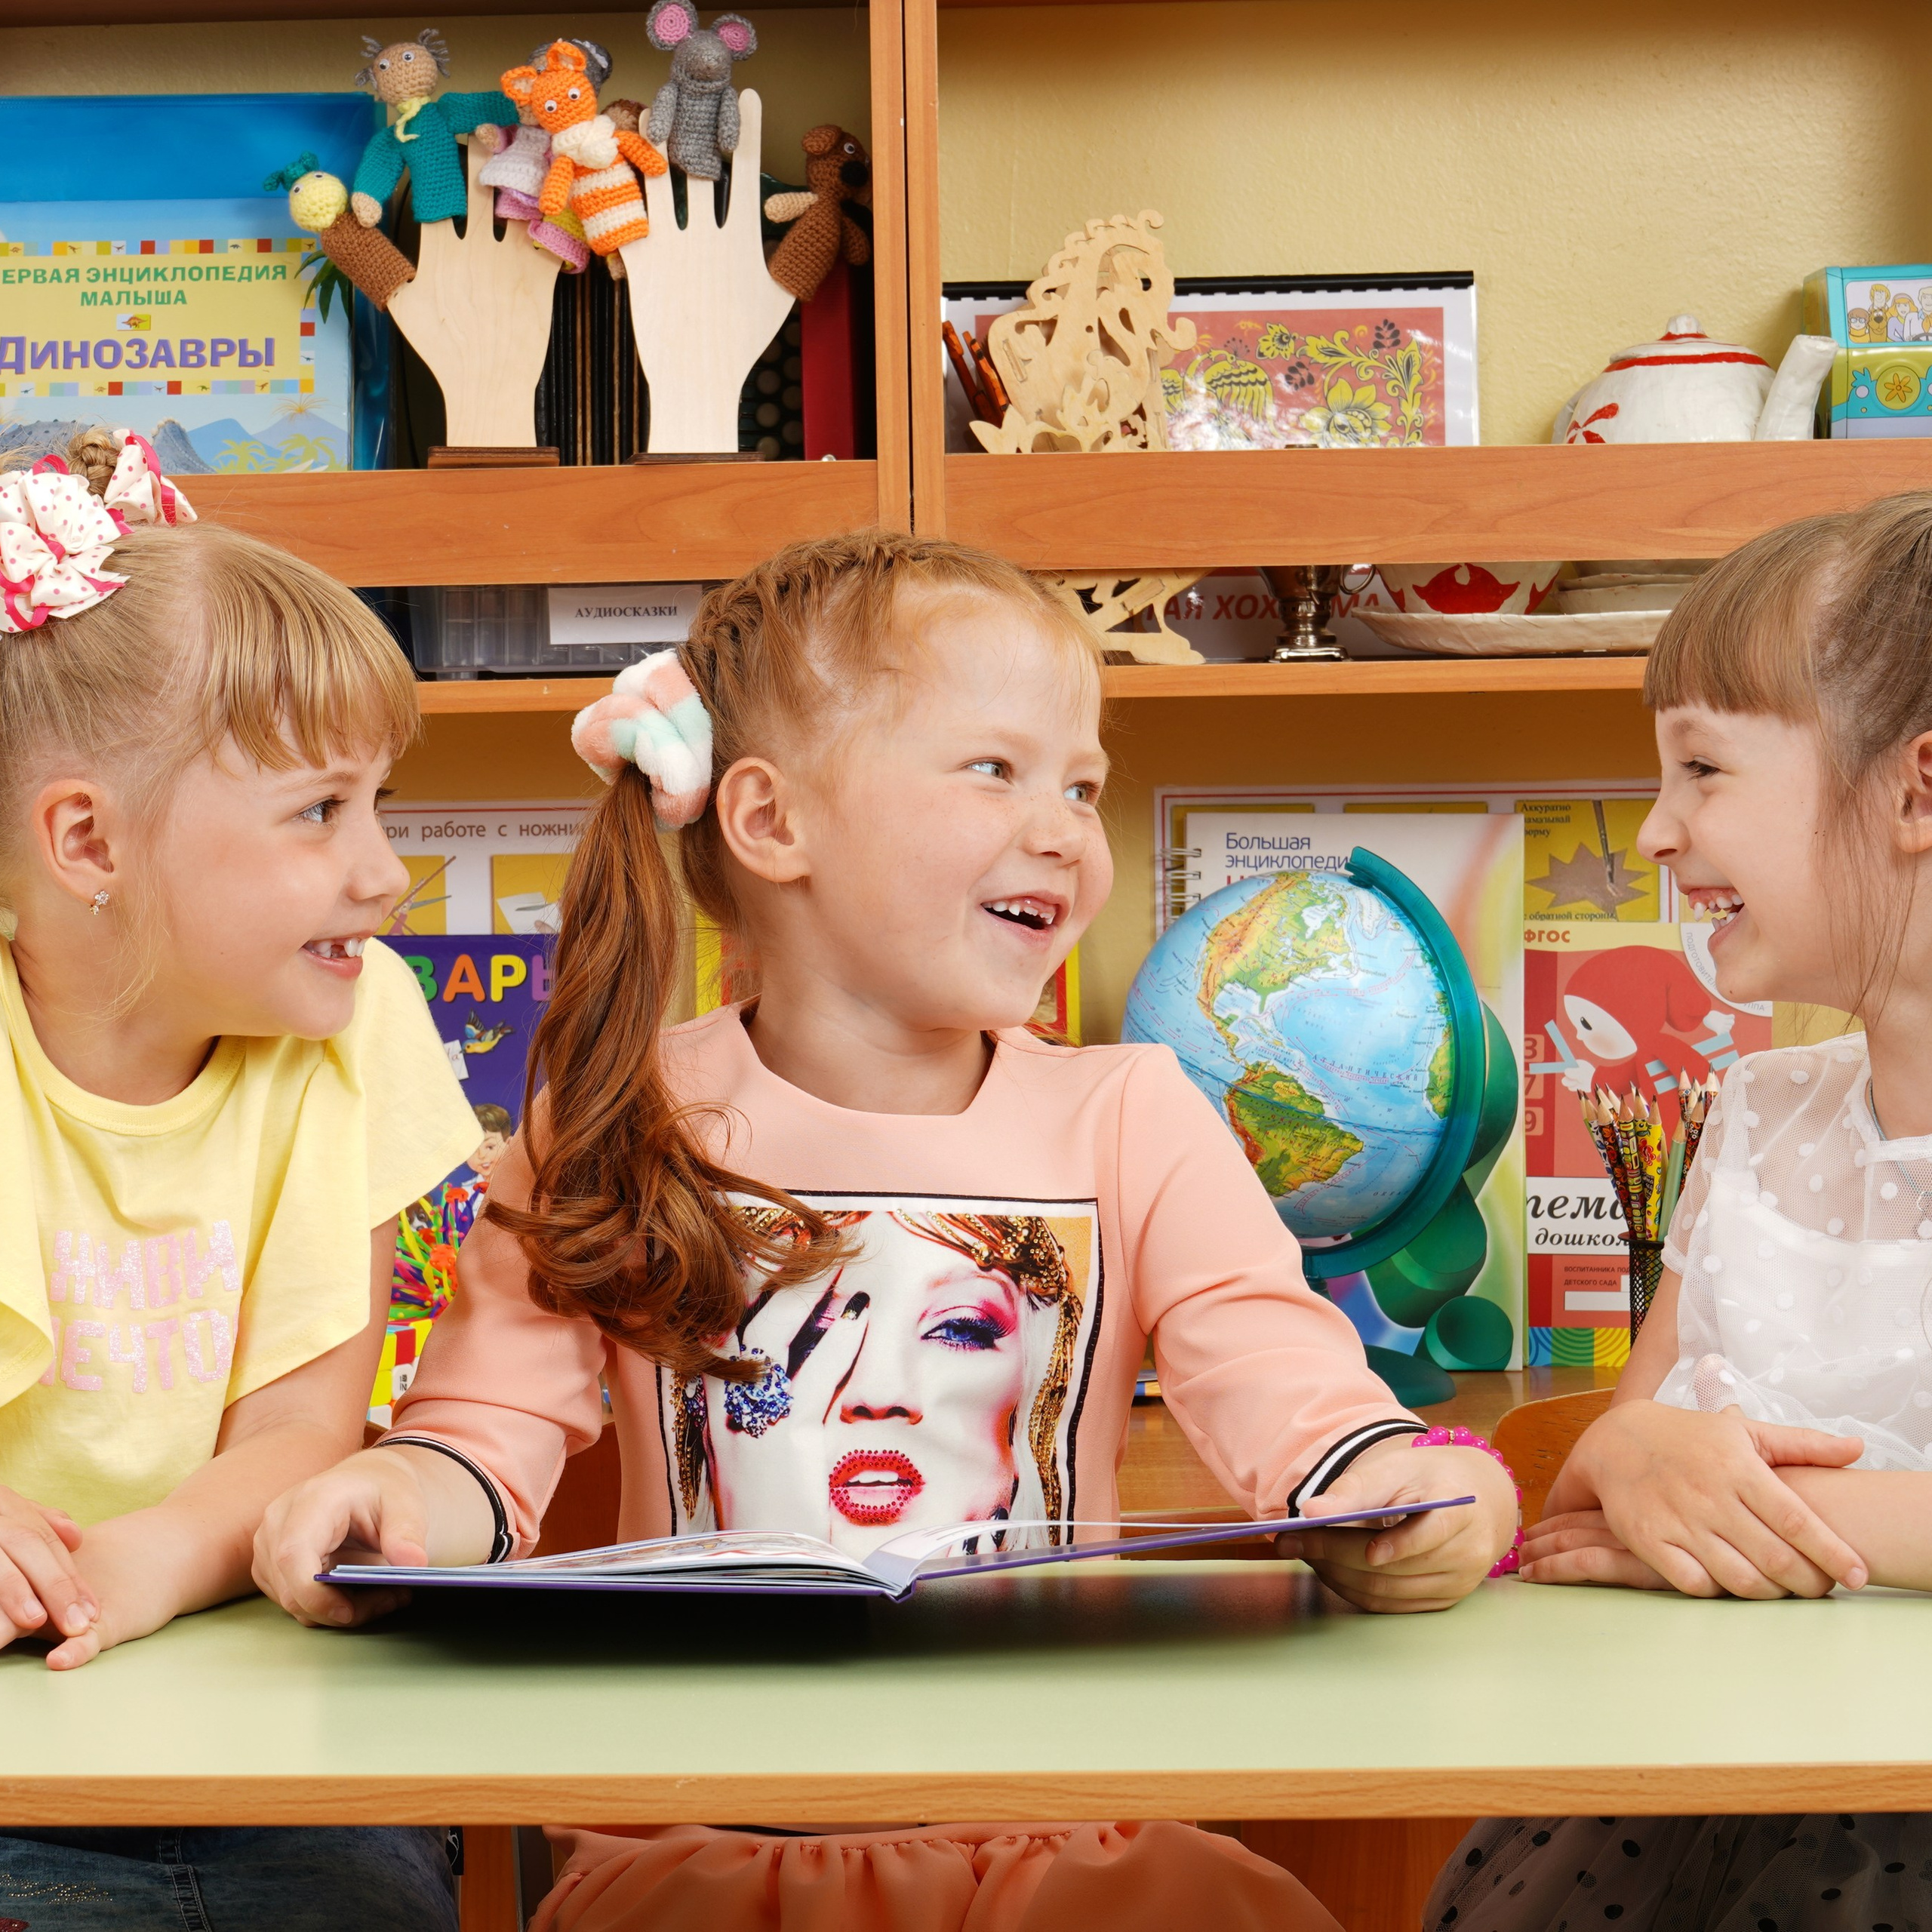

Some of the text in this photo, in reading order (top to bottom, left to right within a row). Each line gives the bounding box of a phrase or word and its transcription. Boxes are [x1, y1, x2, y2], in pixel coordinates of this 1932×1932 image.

[2, 265, 287, 285] ЕРВАЯ ЭНЦИКЛОПЕДИЯ
[80, 290, 188, 306] МАЛЫША
[0, 337, 275, 375] ДИНОЗАВРЫ
[575, 606, 678, 619] АУДИОСКАЗКИ
[1212, 593, 1380, 620] ХОХМА
[382, 825, 409, 838] ри
[422, 821, 486, 841] работе
[497, 824, 507, 837] с
[1226, 832, 1311, 851] Большая
[1529, 911, 1573, 921] обратной
[1524, 929, 1571, 943] ФГОС
[1686, 932, 1717, 989] ПОДГОТОВИТЕЛ
[38, 1309, 238, 1393] ЕЧТО
